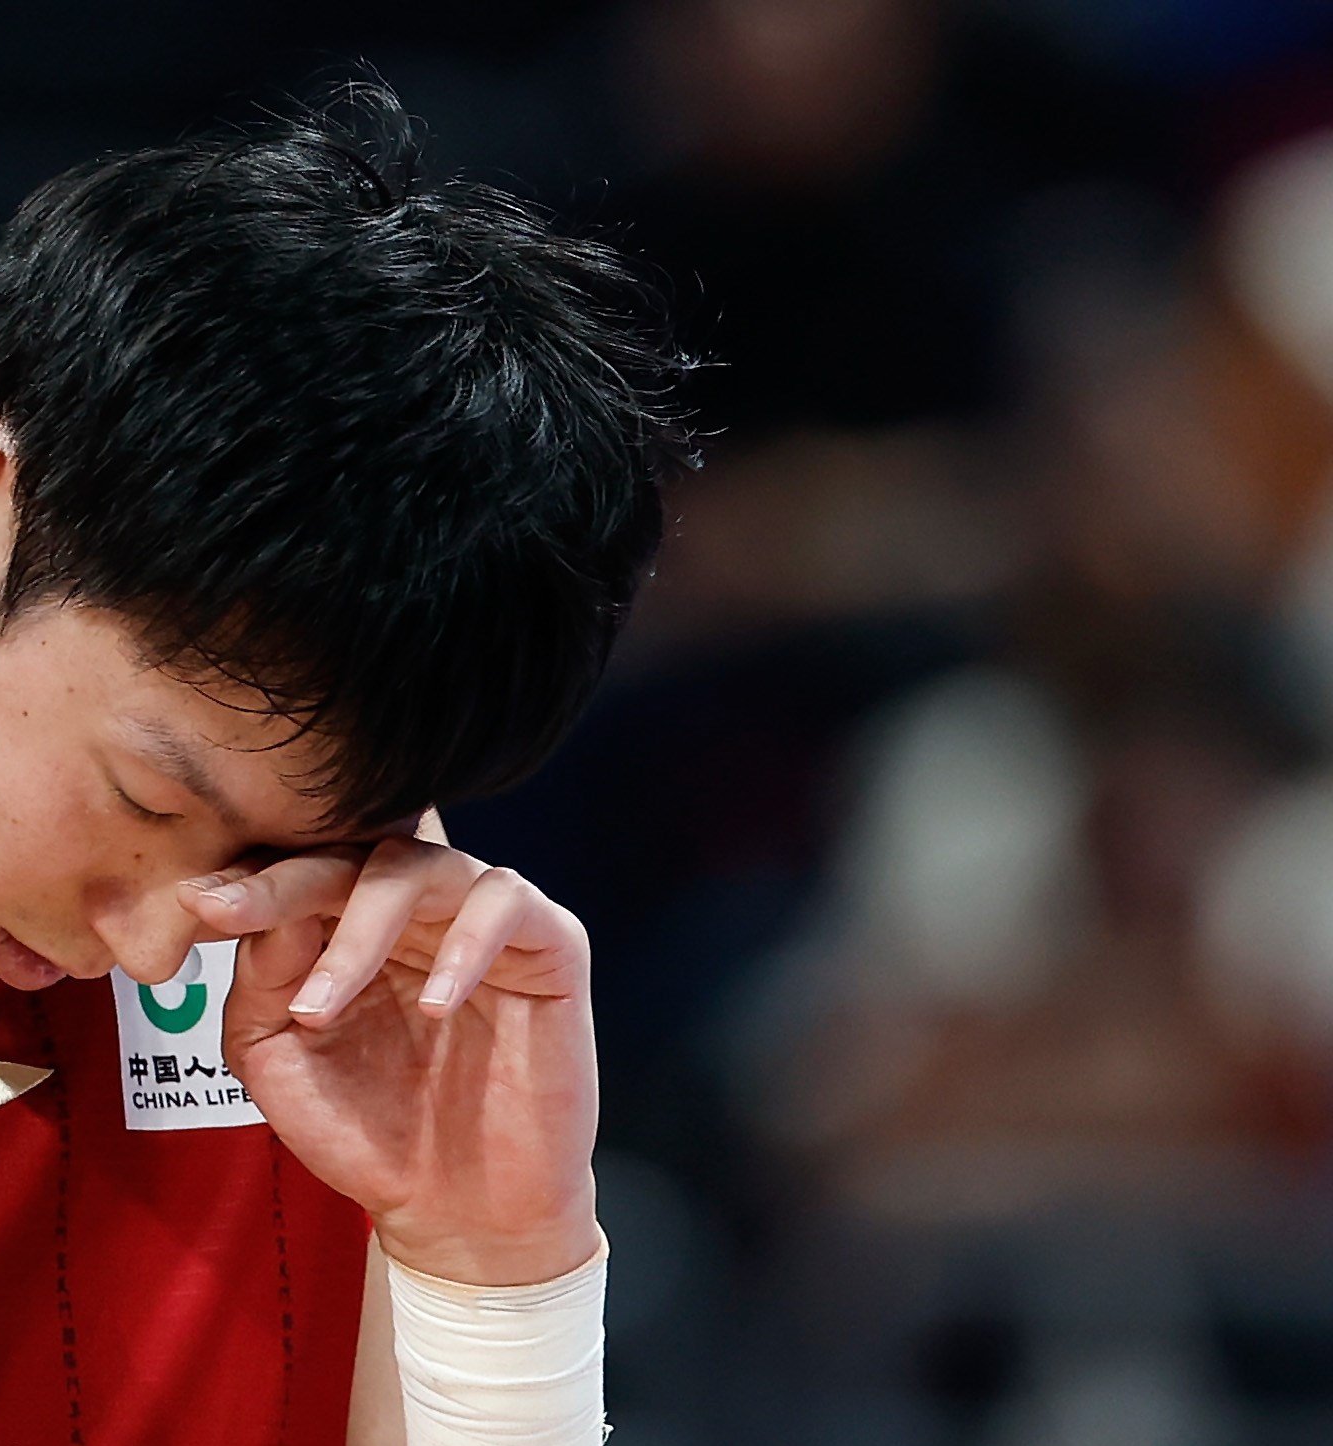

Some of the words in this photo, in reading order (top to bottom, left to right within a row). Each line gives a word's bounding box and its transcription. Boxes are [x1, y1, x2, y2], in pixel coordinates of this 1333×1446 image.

[128, 1053, 231, 1086] 中国人
[132, 1091, 199, 1110] CHINA
